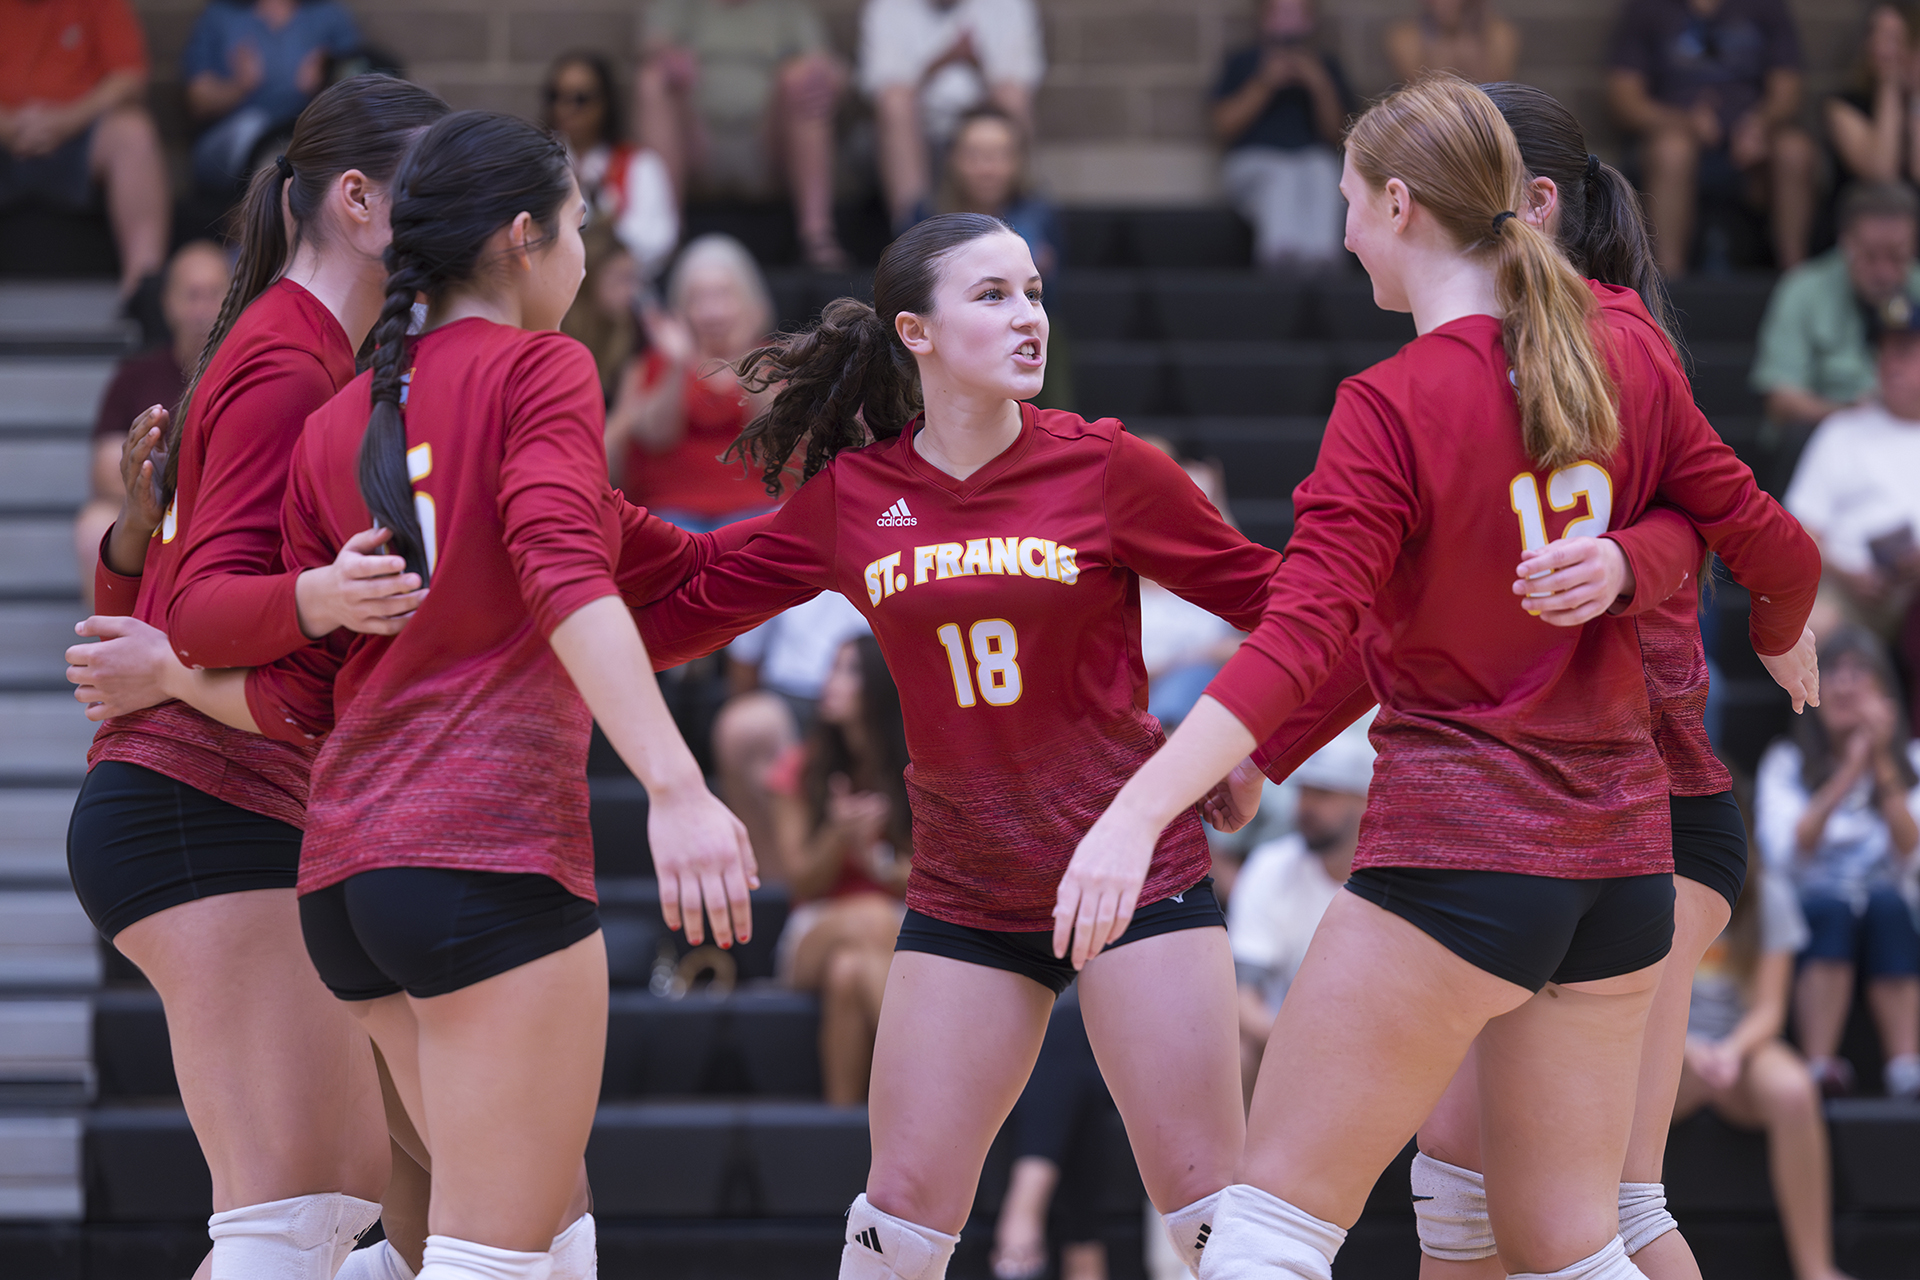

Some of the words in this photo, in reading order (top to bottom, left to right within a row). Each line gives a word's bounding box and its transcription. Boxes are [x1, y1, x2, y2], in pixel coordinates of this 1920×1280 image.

[876, 515, 918, 527] adidas
[1509, 459, 1613, 615] 12
[864, 550, 908, 608] ST.
[913, 536, 1081, 586] FRANCIS
[936, 617, 1023, 708] 18
